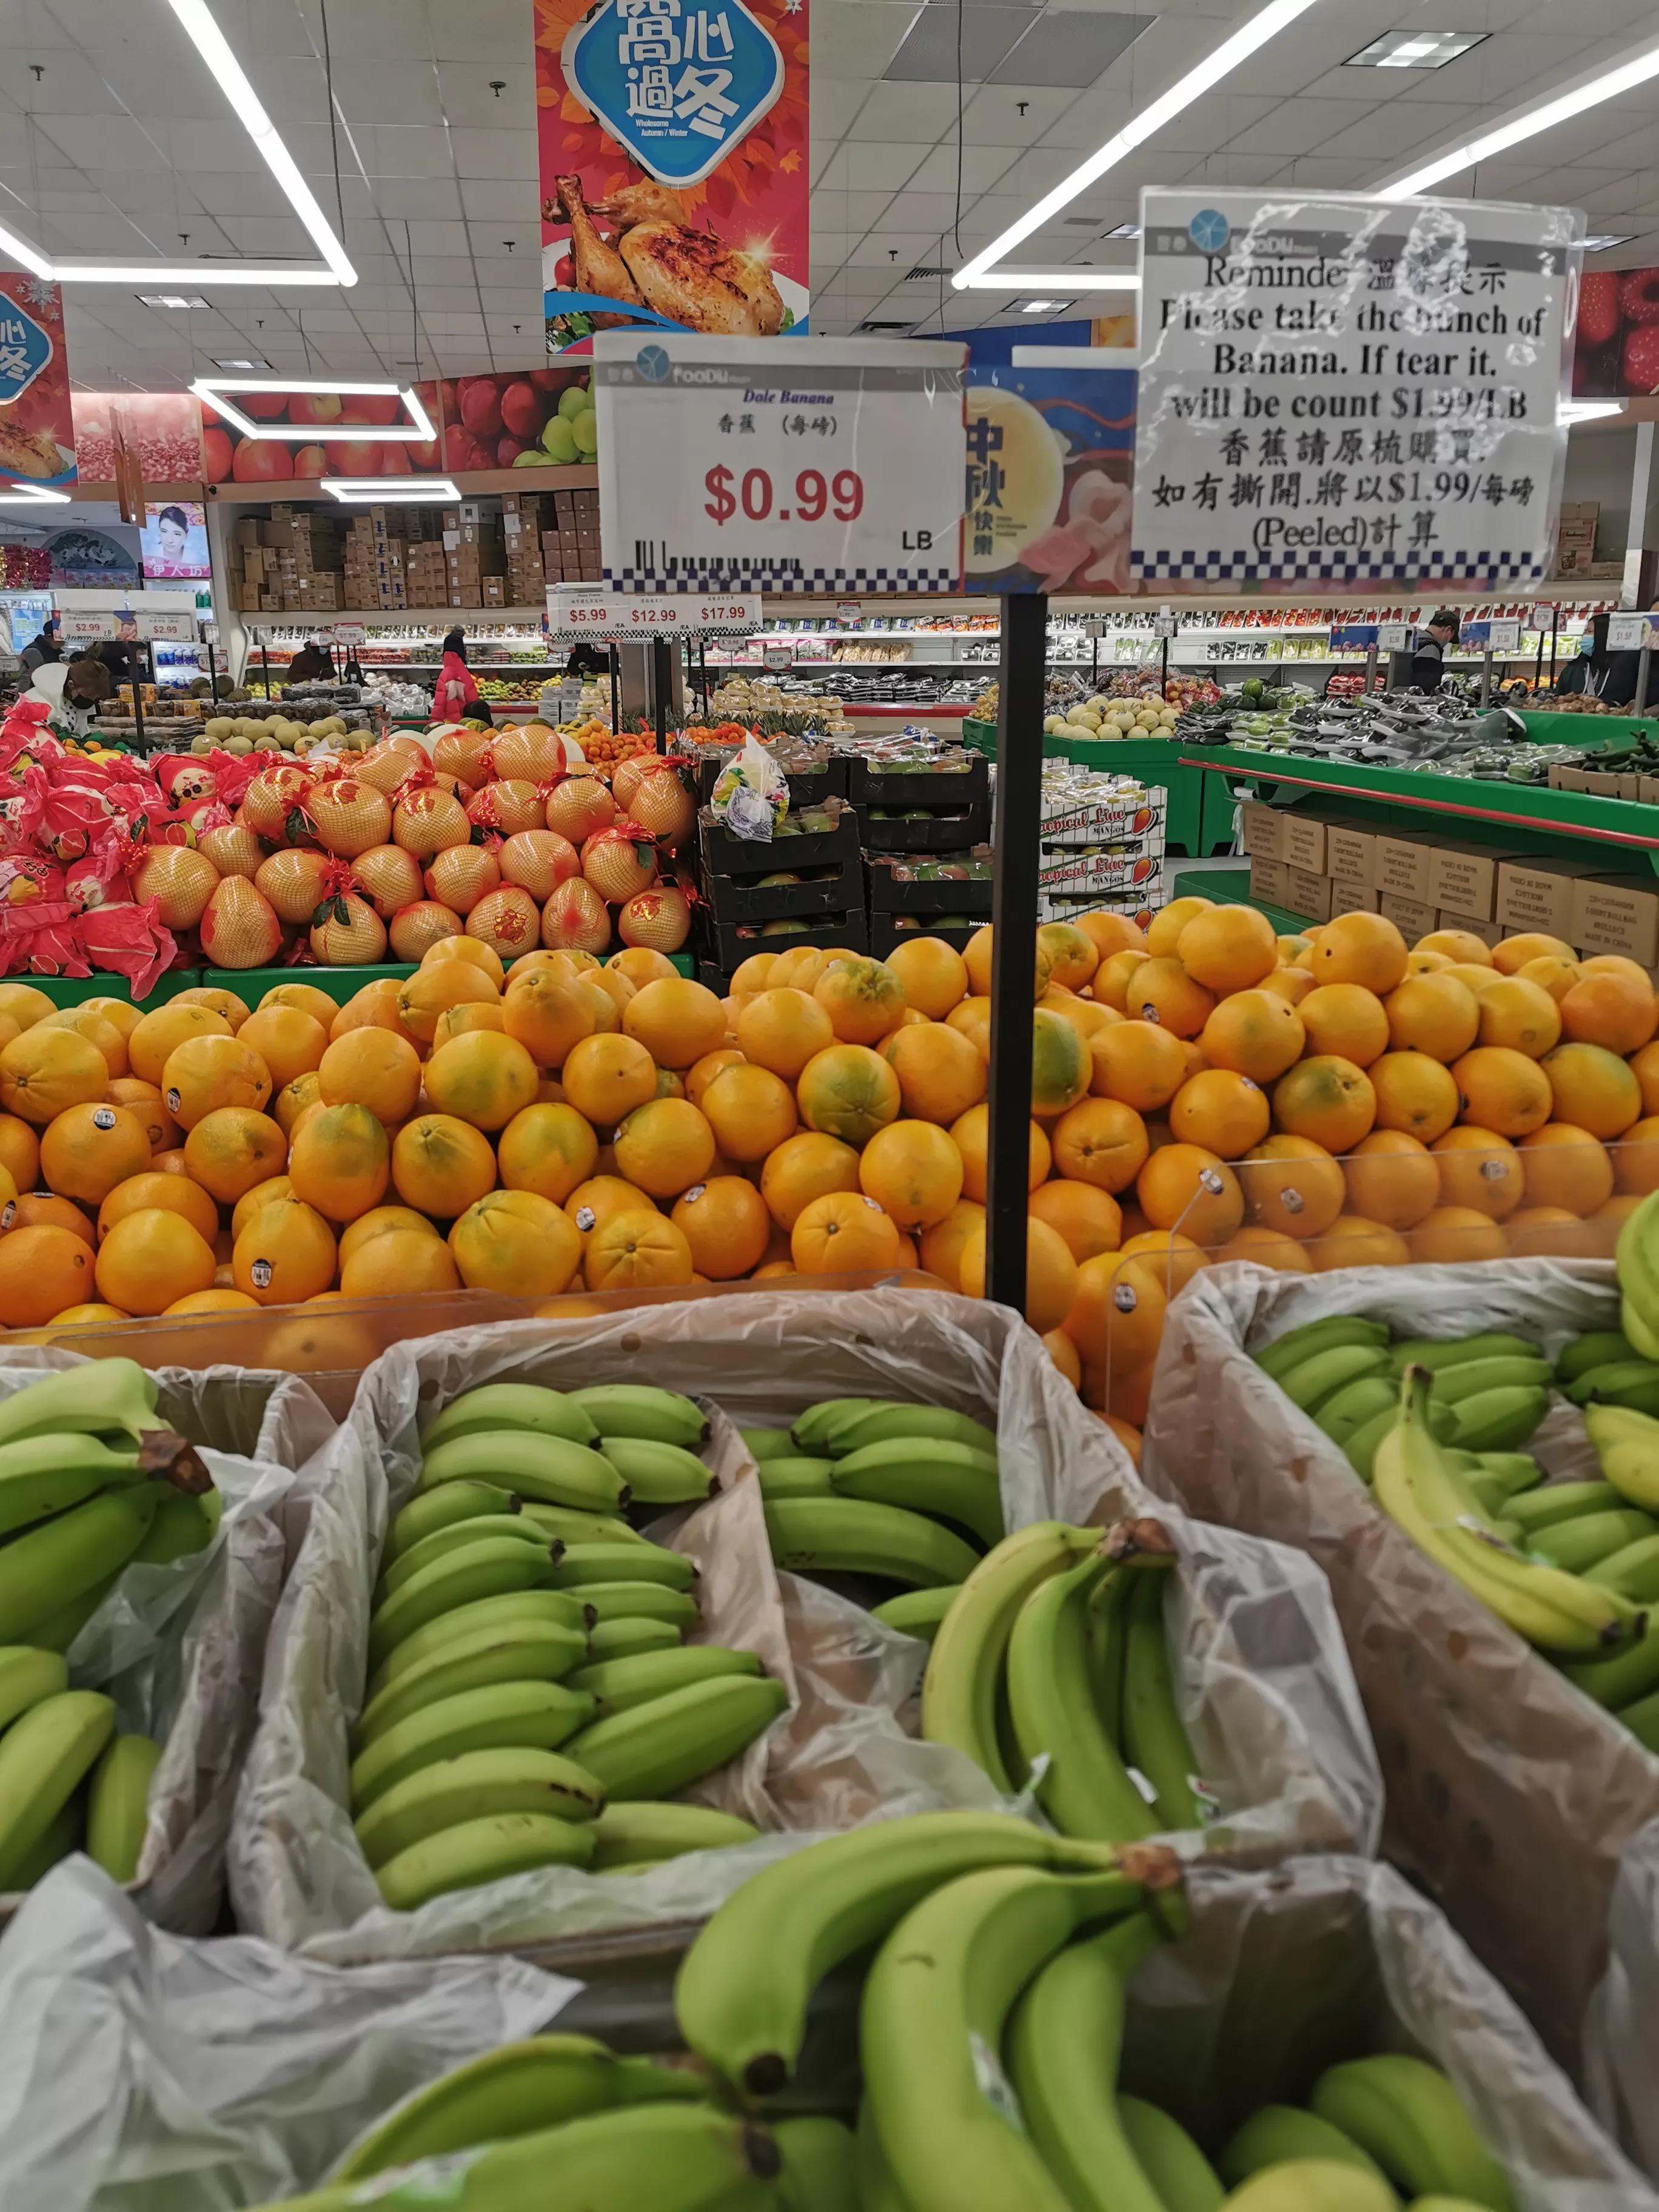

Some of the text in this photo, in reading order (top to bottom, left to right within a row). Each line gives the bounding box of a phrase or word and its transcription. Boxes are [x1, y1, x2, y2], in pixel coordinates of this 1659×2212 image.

[625, 64, 740, 141] 過冬
[669, 129, 688, 137] Winter
[1204, 255, 1352, 288] Reminde
[1518, 307, 1547, 337] of
[1213, 343, 1497, 377] Banana. If tear it.
[743, 388, 835, 405] Dole Banana
[1243, 386, 1281, 418] be
[1290, 389, 1381, 418] count
[718, 413, 756, 434] 香蕉
[704, 464, 864, 526] $0.99
[902, 531, 933, 551] LB
[153, 565, 203, 577] 伊人坊
[569, 608, 606, 623] $5.99
[632, 609, 676, 623] $12.99
[701, 606, 745, 621] $17.99
[75, 623, 100, 632] $2.99
[153, 625, 178, 634] $2.99
[1039, 811, 1090, 836] ropical
[1093, 825, 1125, 835] MANGOS
[1037, 861, 1088, 885] ropical
[1091, 875, 1124, 885] MANGOS
